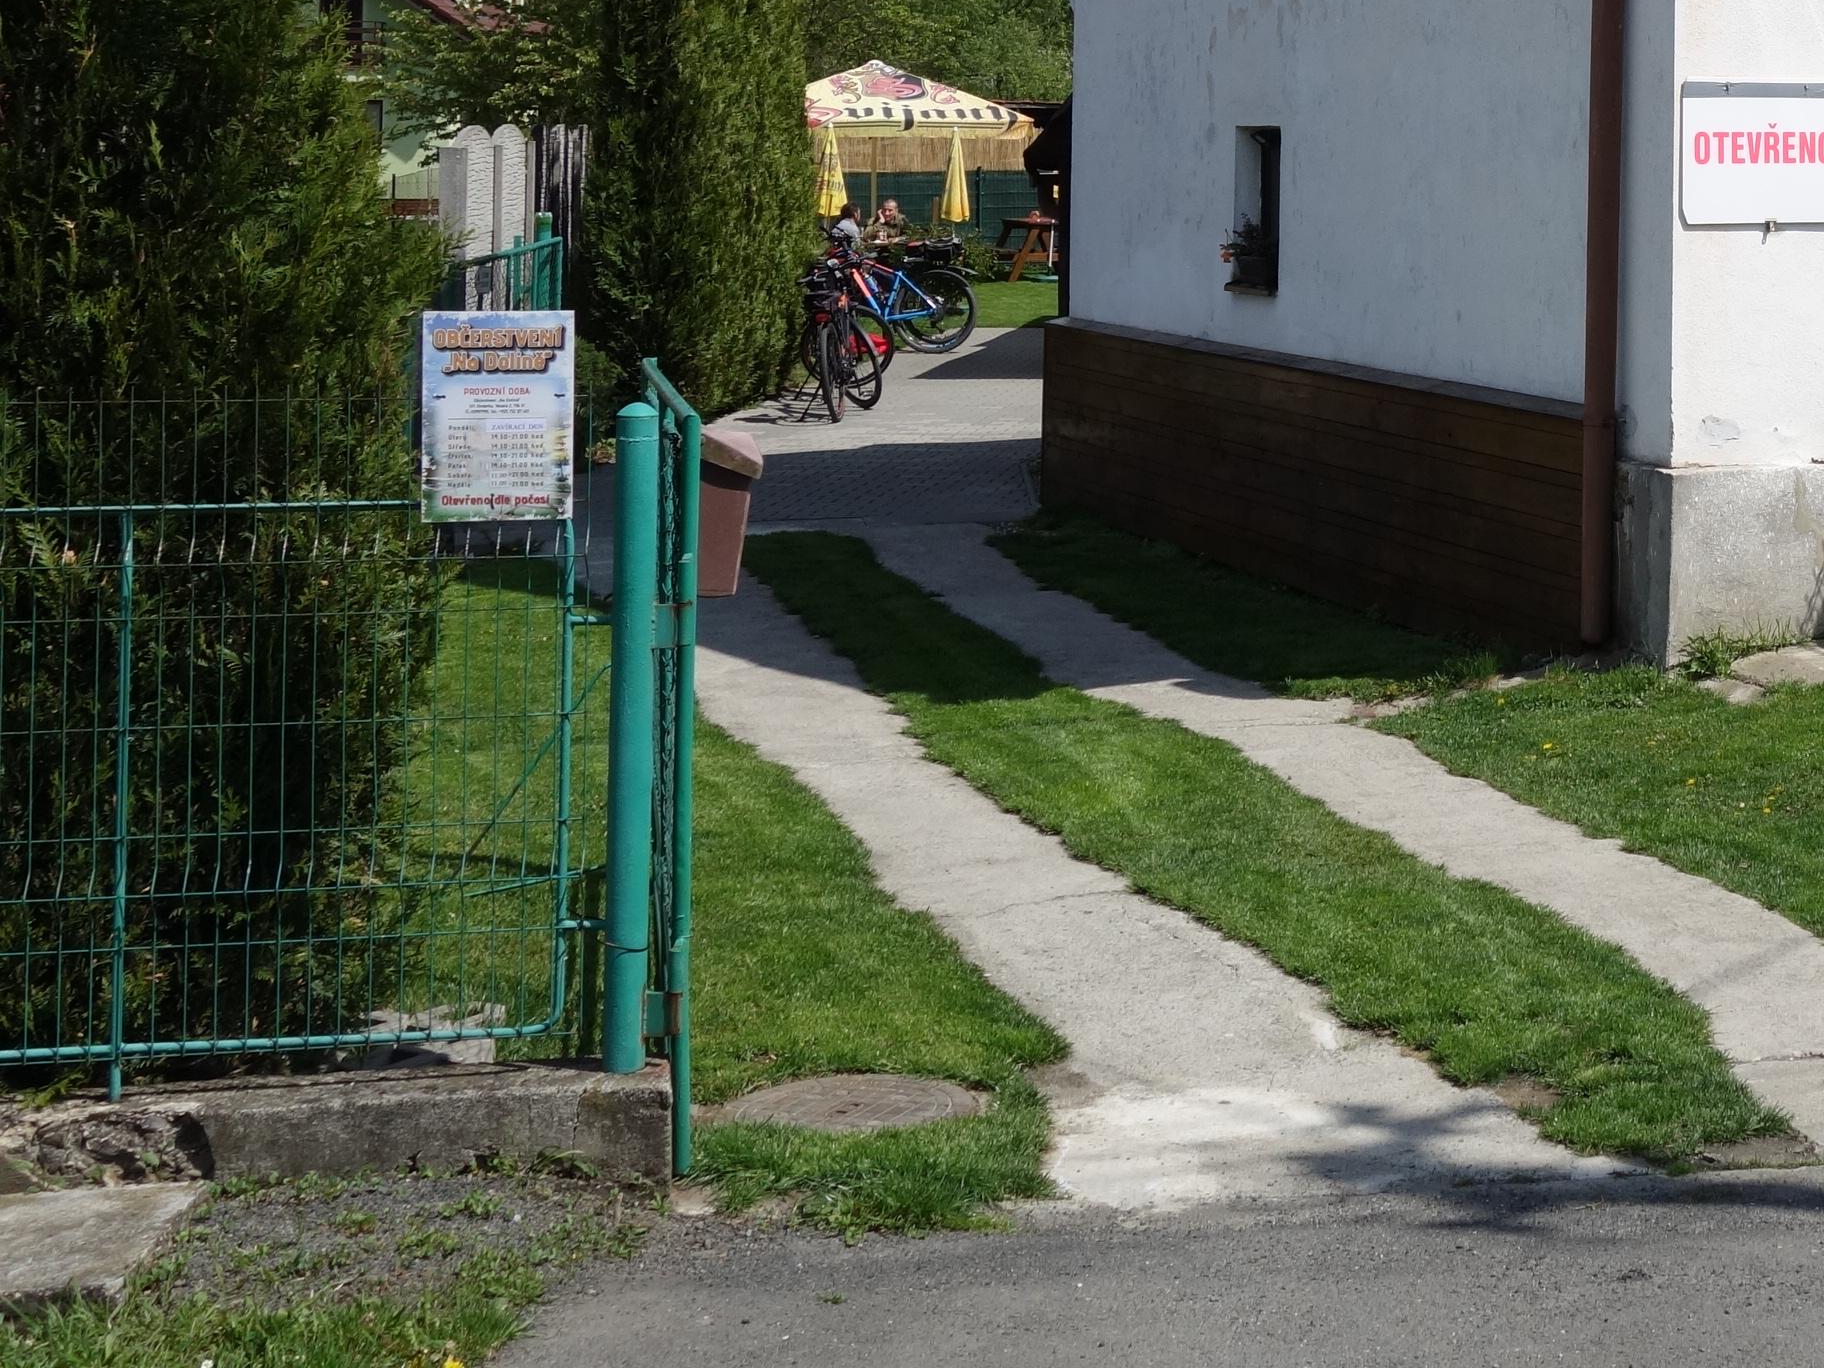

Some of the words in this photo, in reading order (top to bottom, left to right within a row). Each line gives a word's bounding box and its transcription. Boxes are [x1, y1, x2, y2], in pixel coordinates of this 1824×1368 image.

[432, 324, 563, 349] OBČERSTVENÍ
[463, 386, 505, 395] PROVOZNÍ
[508, 387, 530, 395] DOBA
[441, 494, 491, 505] Otevřeno
[494, 495, 510, 505] dle
[514, 494, 549, 506] počasí
